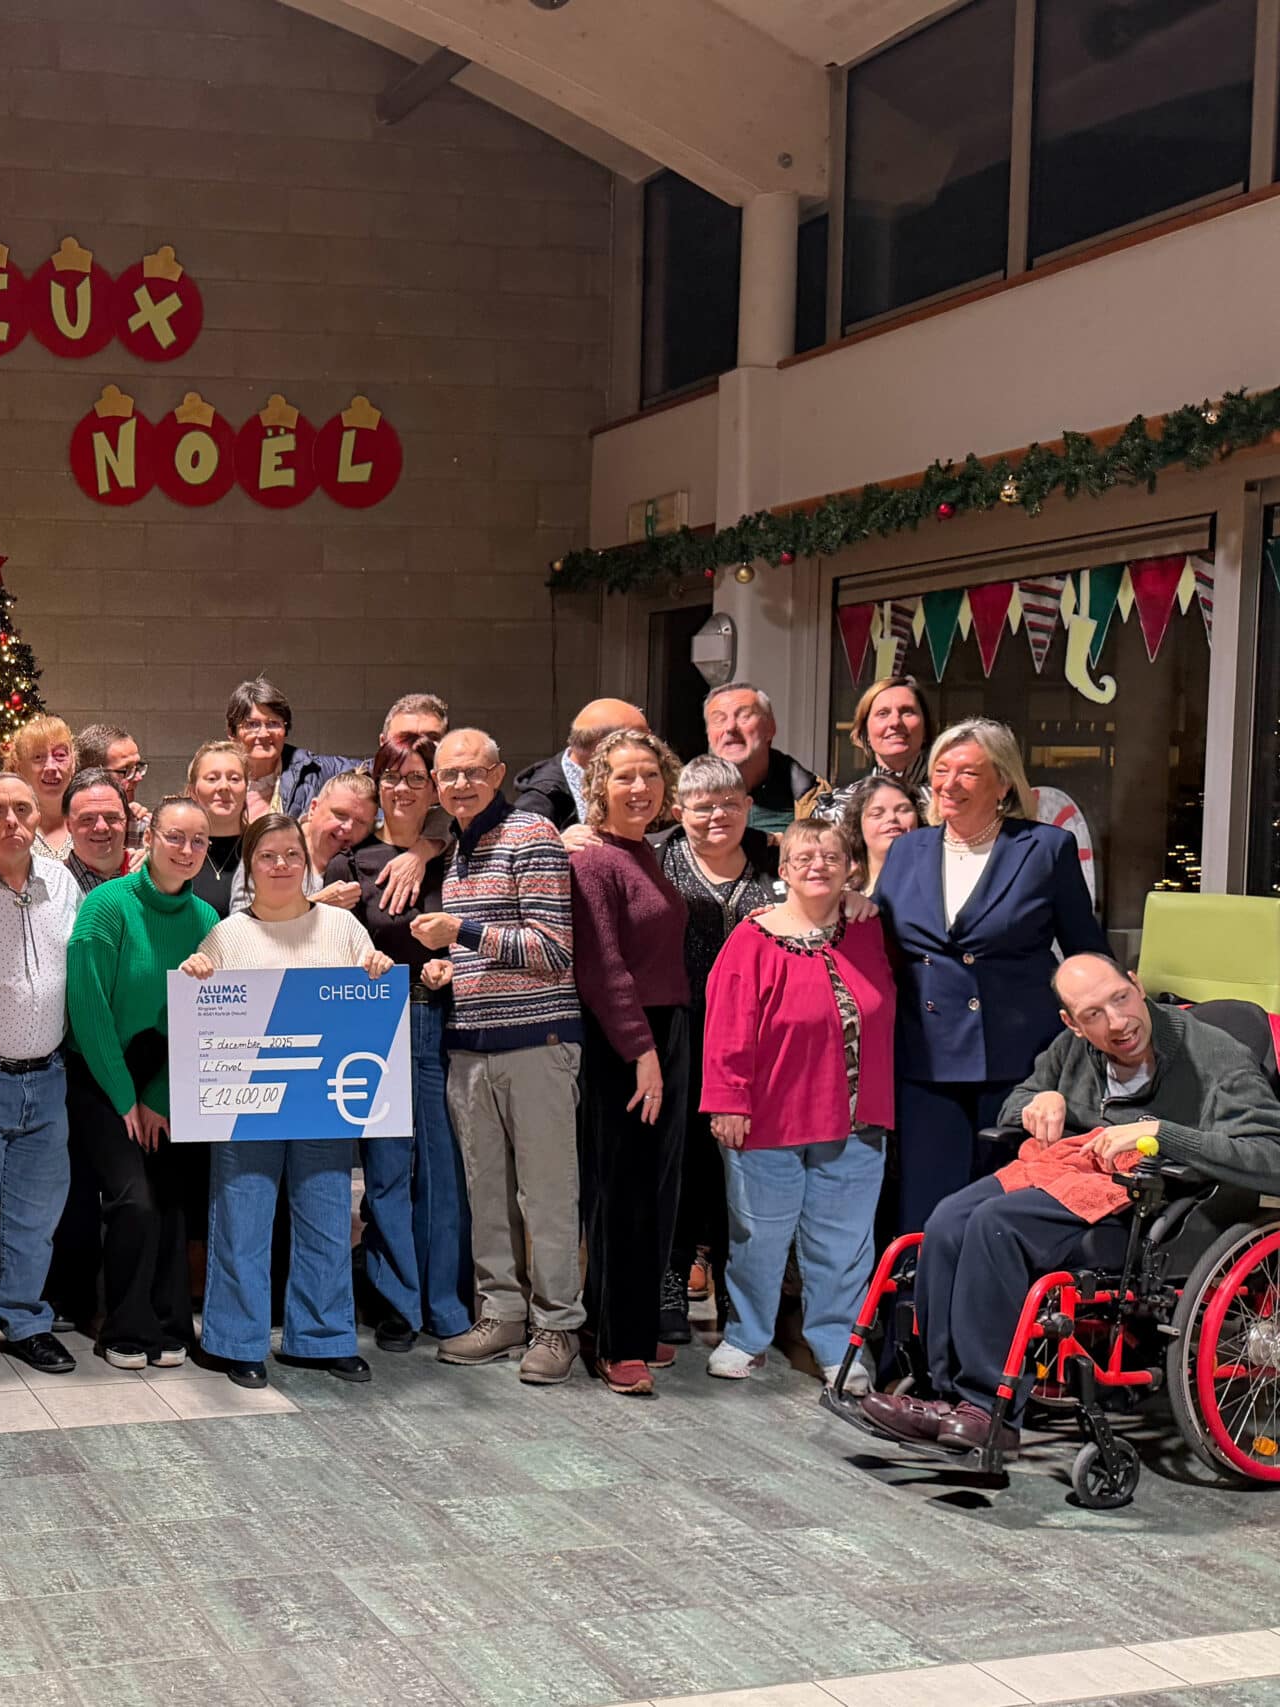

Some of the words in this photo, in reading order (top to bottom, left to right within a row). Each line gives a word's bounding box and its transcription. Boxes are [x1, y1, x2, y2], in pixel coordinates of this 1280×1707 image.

[92, 417, 373, 495] NOËL
[199, 984, 247, 994] ALUMAC
[319, 984, 391, 1001] CHEQUE
[195, 994, 247, 1004] ASTEMAC
[200, 1037, 213, 1050] 3
[269, 1037, 294, 1049] 2025
